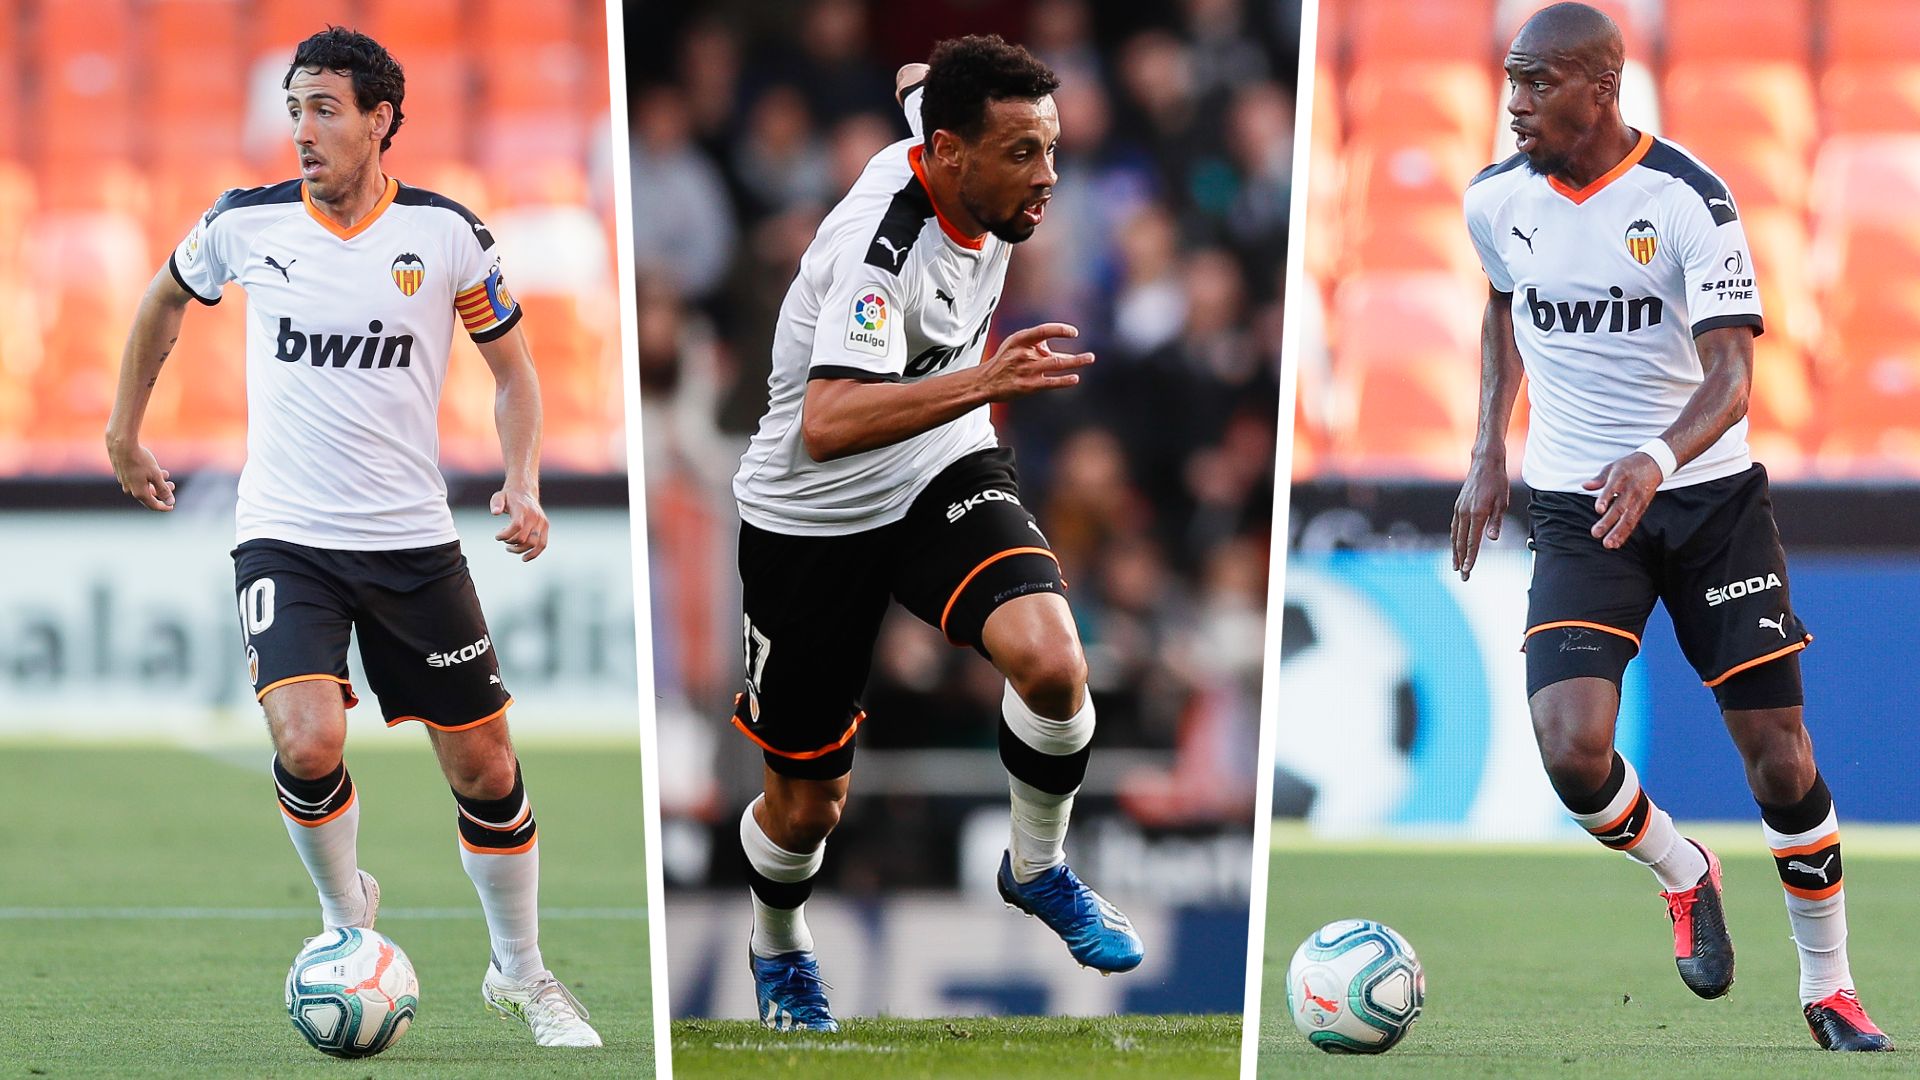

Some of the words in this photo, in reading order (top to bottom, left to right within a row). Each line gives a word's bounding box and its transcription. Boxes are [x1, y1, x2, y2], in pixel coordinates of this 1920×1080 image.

[1701, 278, 1757, 292] SAILU
[1717, 290, 1753, 301] TYRE
[1526, 285, 1664, 333] bwin
[274, 317, 414, 369] bwin
[849, 331, 885, 348] LaLiga
[946, 489, 1021, 523] ŠKOD
[1705, 573, 1782, 607] ŠKODA
[239, 577, 275, 646] 10
